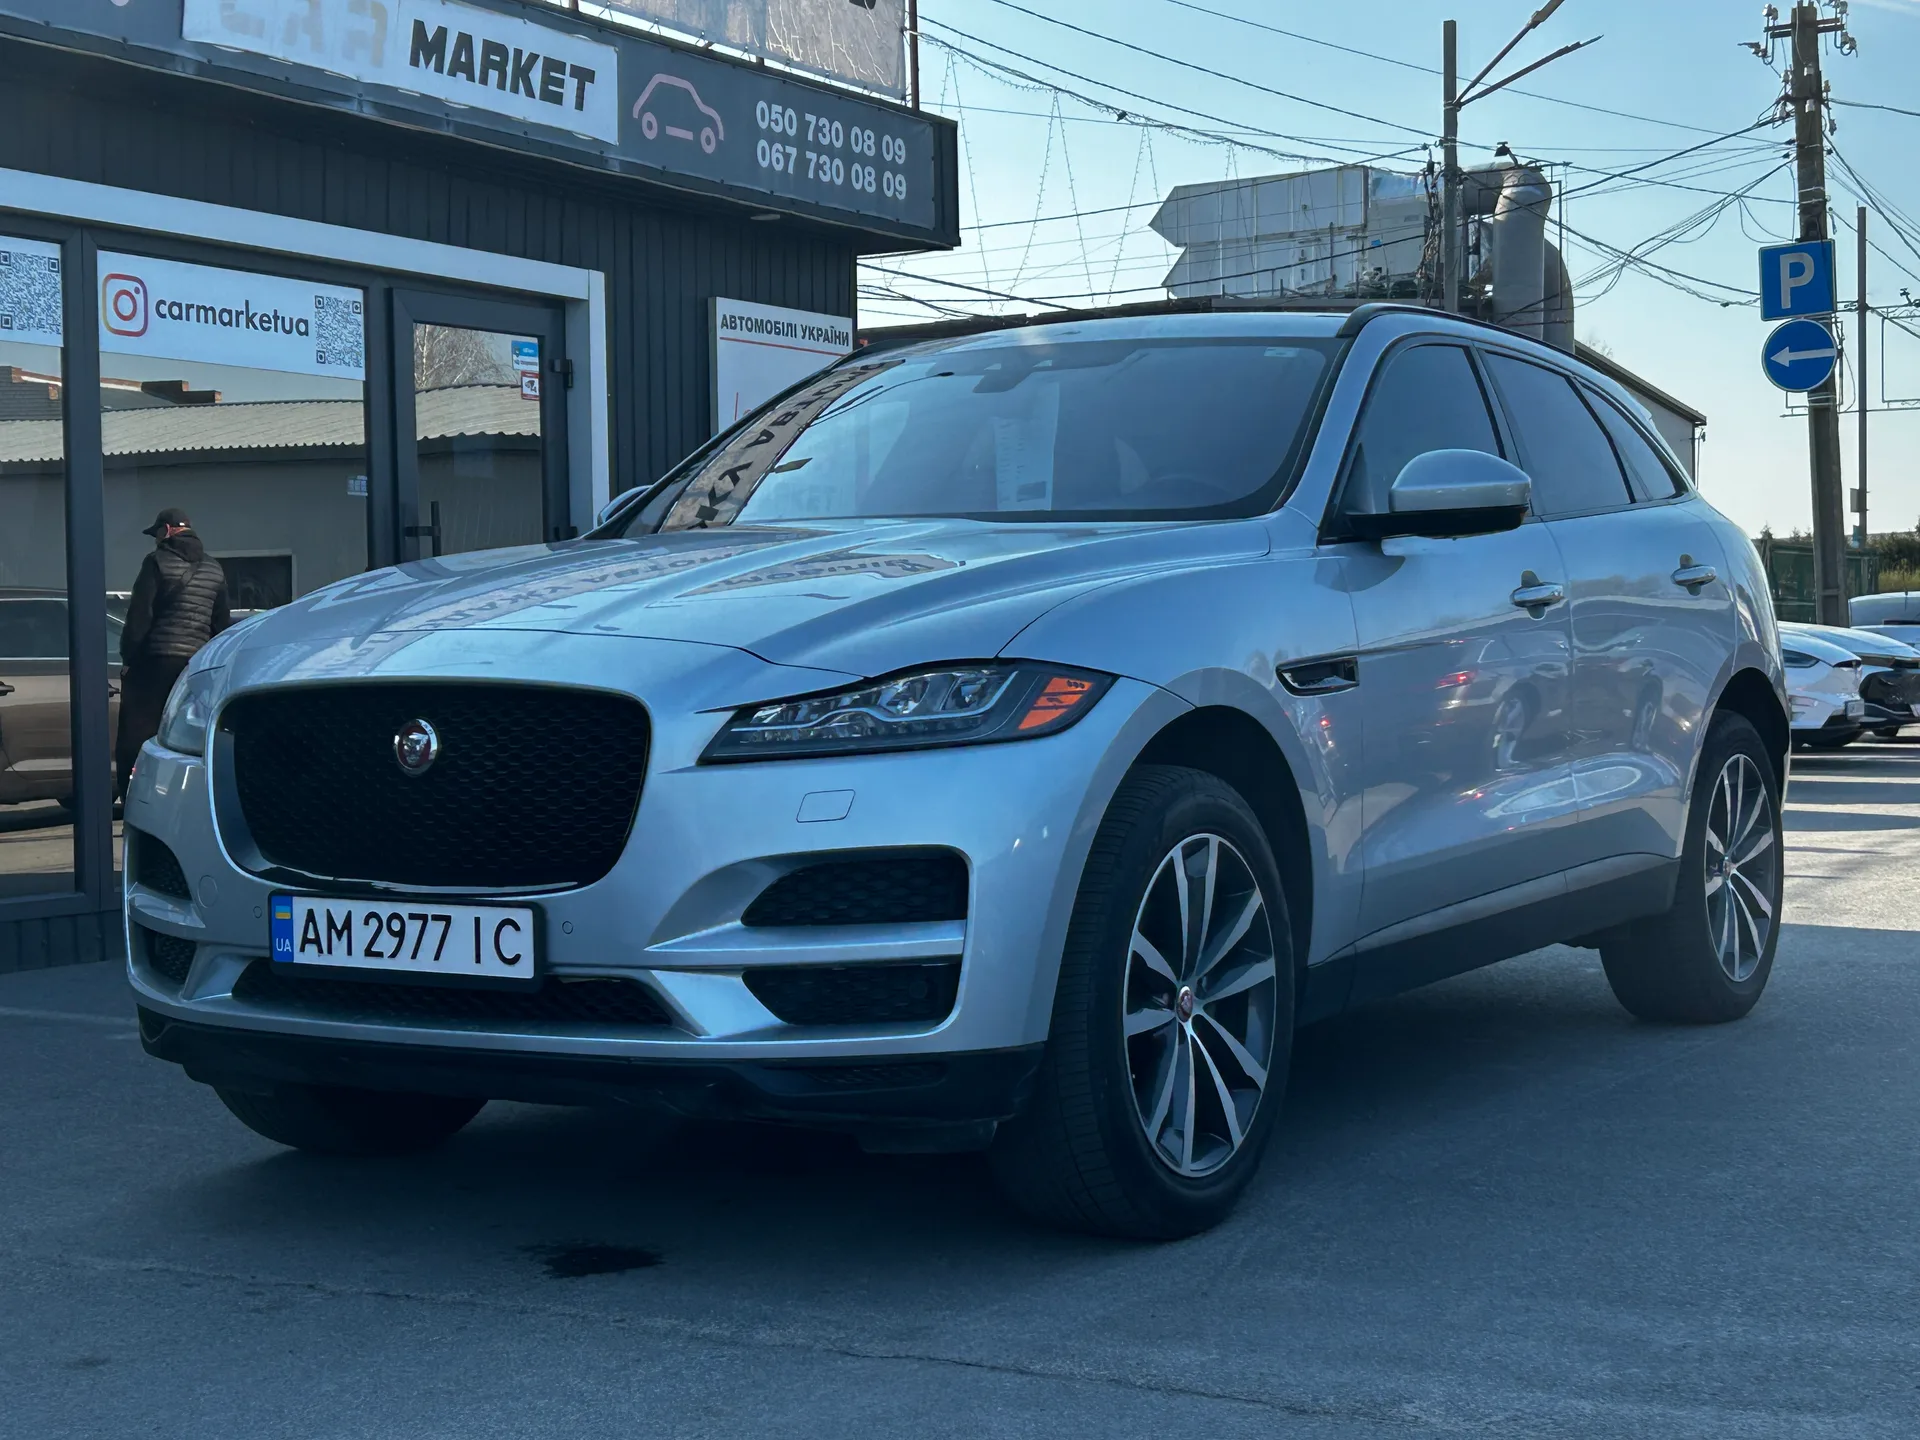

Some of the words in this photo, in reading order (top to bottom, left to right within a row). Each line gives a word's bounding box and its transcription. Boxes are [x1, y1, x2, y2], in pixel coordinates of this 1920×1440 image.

[409, 19, 595, 112] MARKET
[756, 100, 797, 137] 050
[805, 113, 844, 148] 730
[850, 125, 876, 157] 08
[882, 134, 906, 164] 09
[756, 139, 798, 175] 067
[805, 150, 844, 186] 730
[851, 163, 876, 193] 08
[883, 171, 907, 200] 09
[1779, 252, 1815, 310] P
[155, 298, 310, 337] carmarketua
[720, 313, 797, 339] АВТОМОБІЛІ
[801, 324, 849, 347] УКРАЇНИ
[275, 937, 292, 953] UA
[299, 908, 352, 956] AM
[363, 911, 452, 962] 2977
[474, 916, 522, 965] IC
